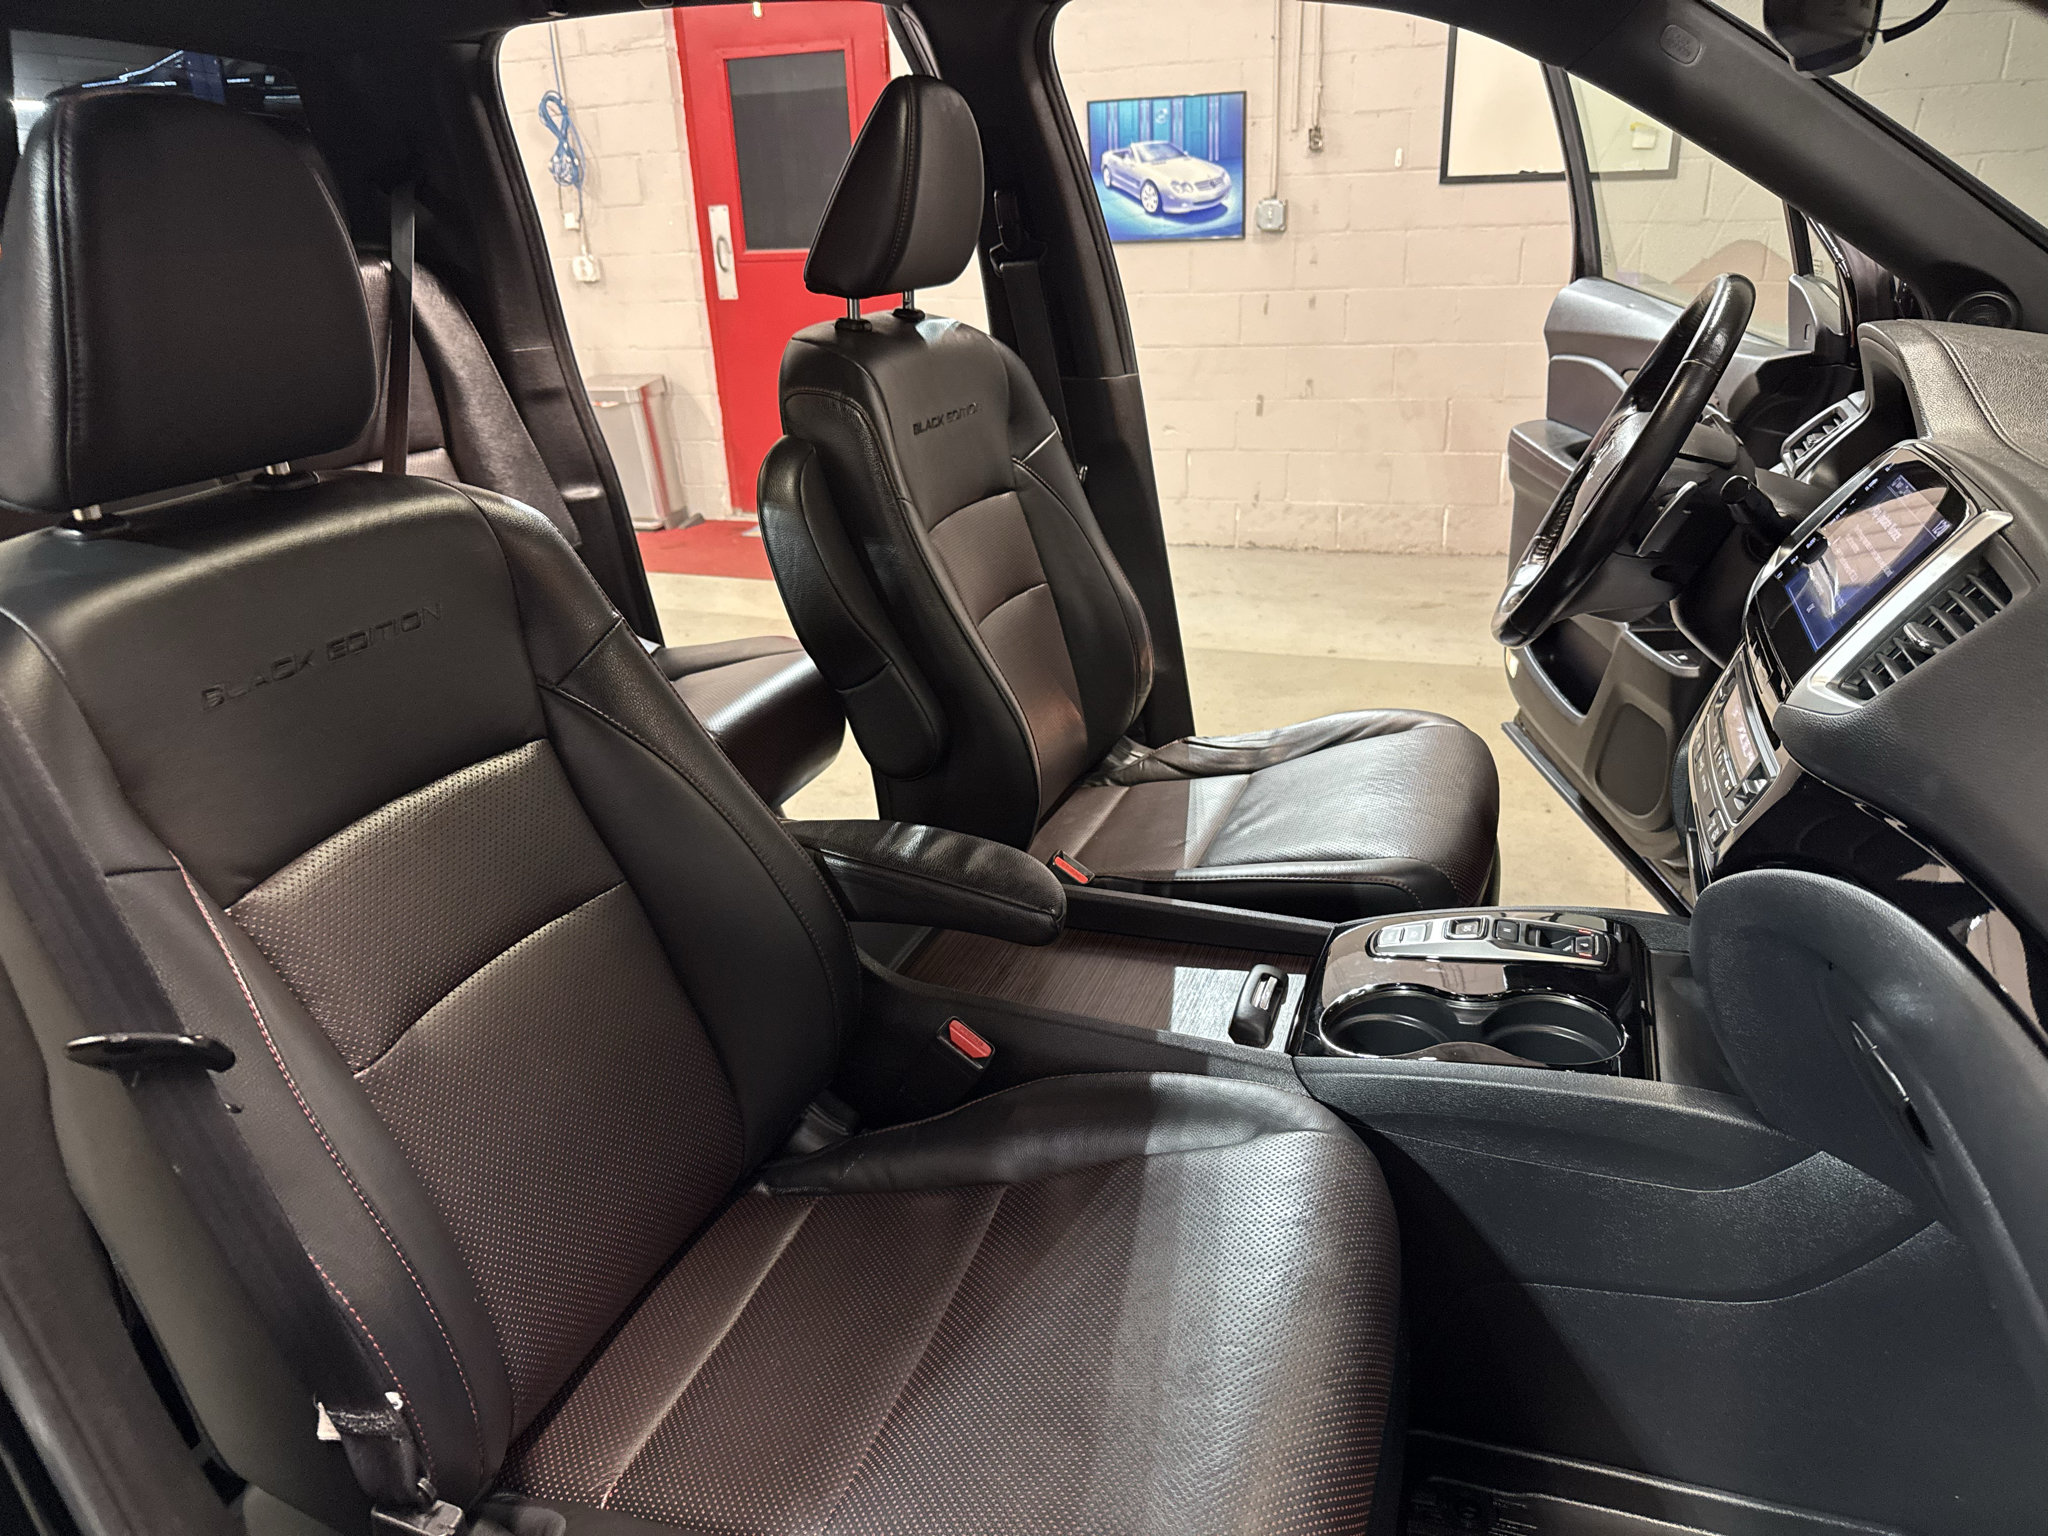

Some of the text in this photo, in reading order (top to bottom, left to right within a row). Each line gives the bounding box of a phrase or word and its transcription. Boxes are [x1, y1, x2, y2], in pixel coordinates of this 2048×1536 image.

[912, 413, 945, 436] BLACK
[201, 602, 442, 711] BLACK EDITION
